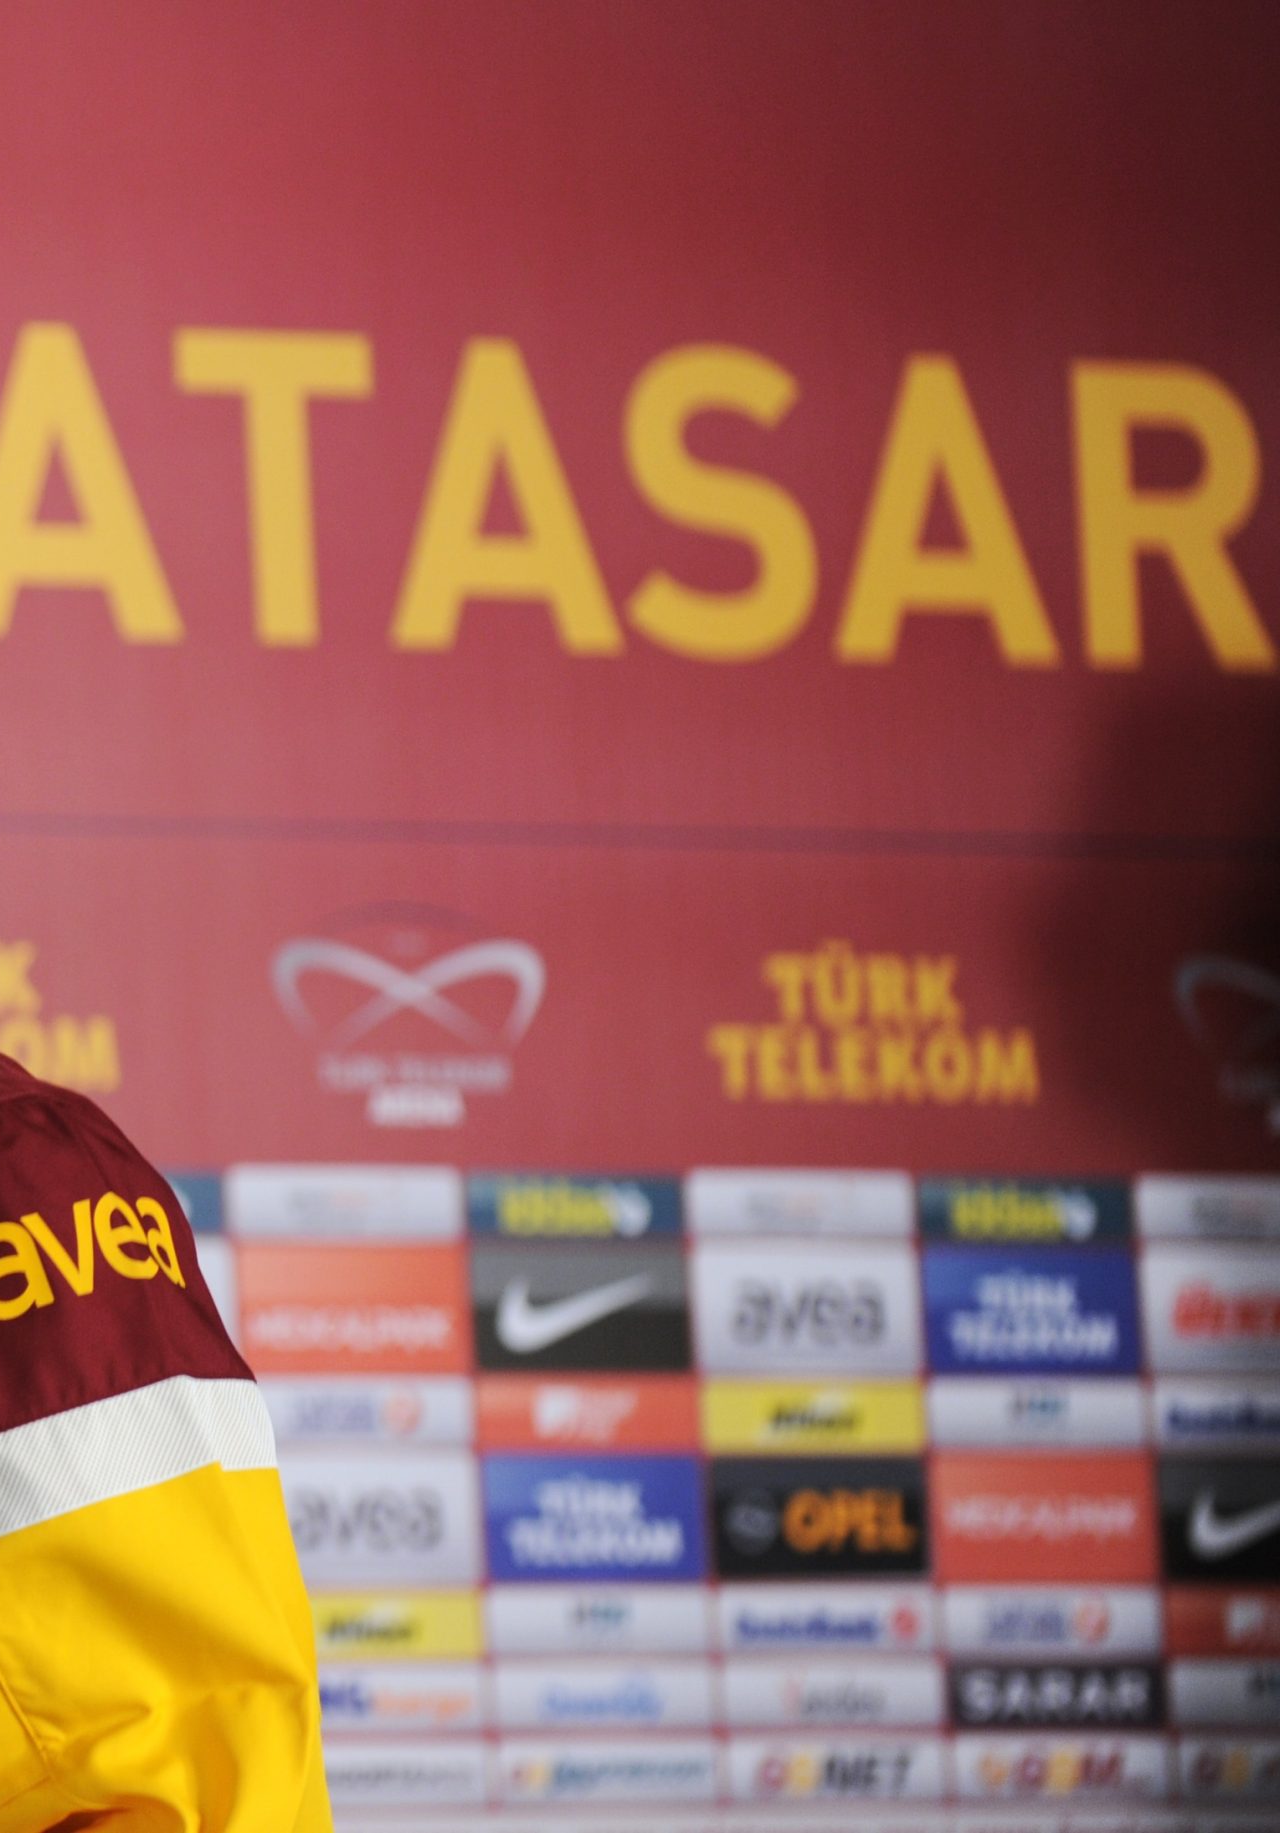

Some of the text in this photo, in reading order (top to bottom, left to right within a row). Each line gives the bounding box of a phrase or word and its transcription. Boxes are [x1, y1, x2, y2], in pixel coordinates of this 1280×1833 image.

[764, 938, 962, 1023] TÜRK
[709, 1022, 1040, 1104] TELEKOM
[731, 1272, 888, 1347] avea
[782, 1488, 916, 1553] OPEL
